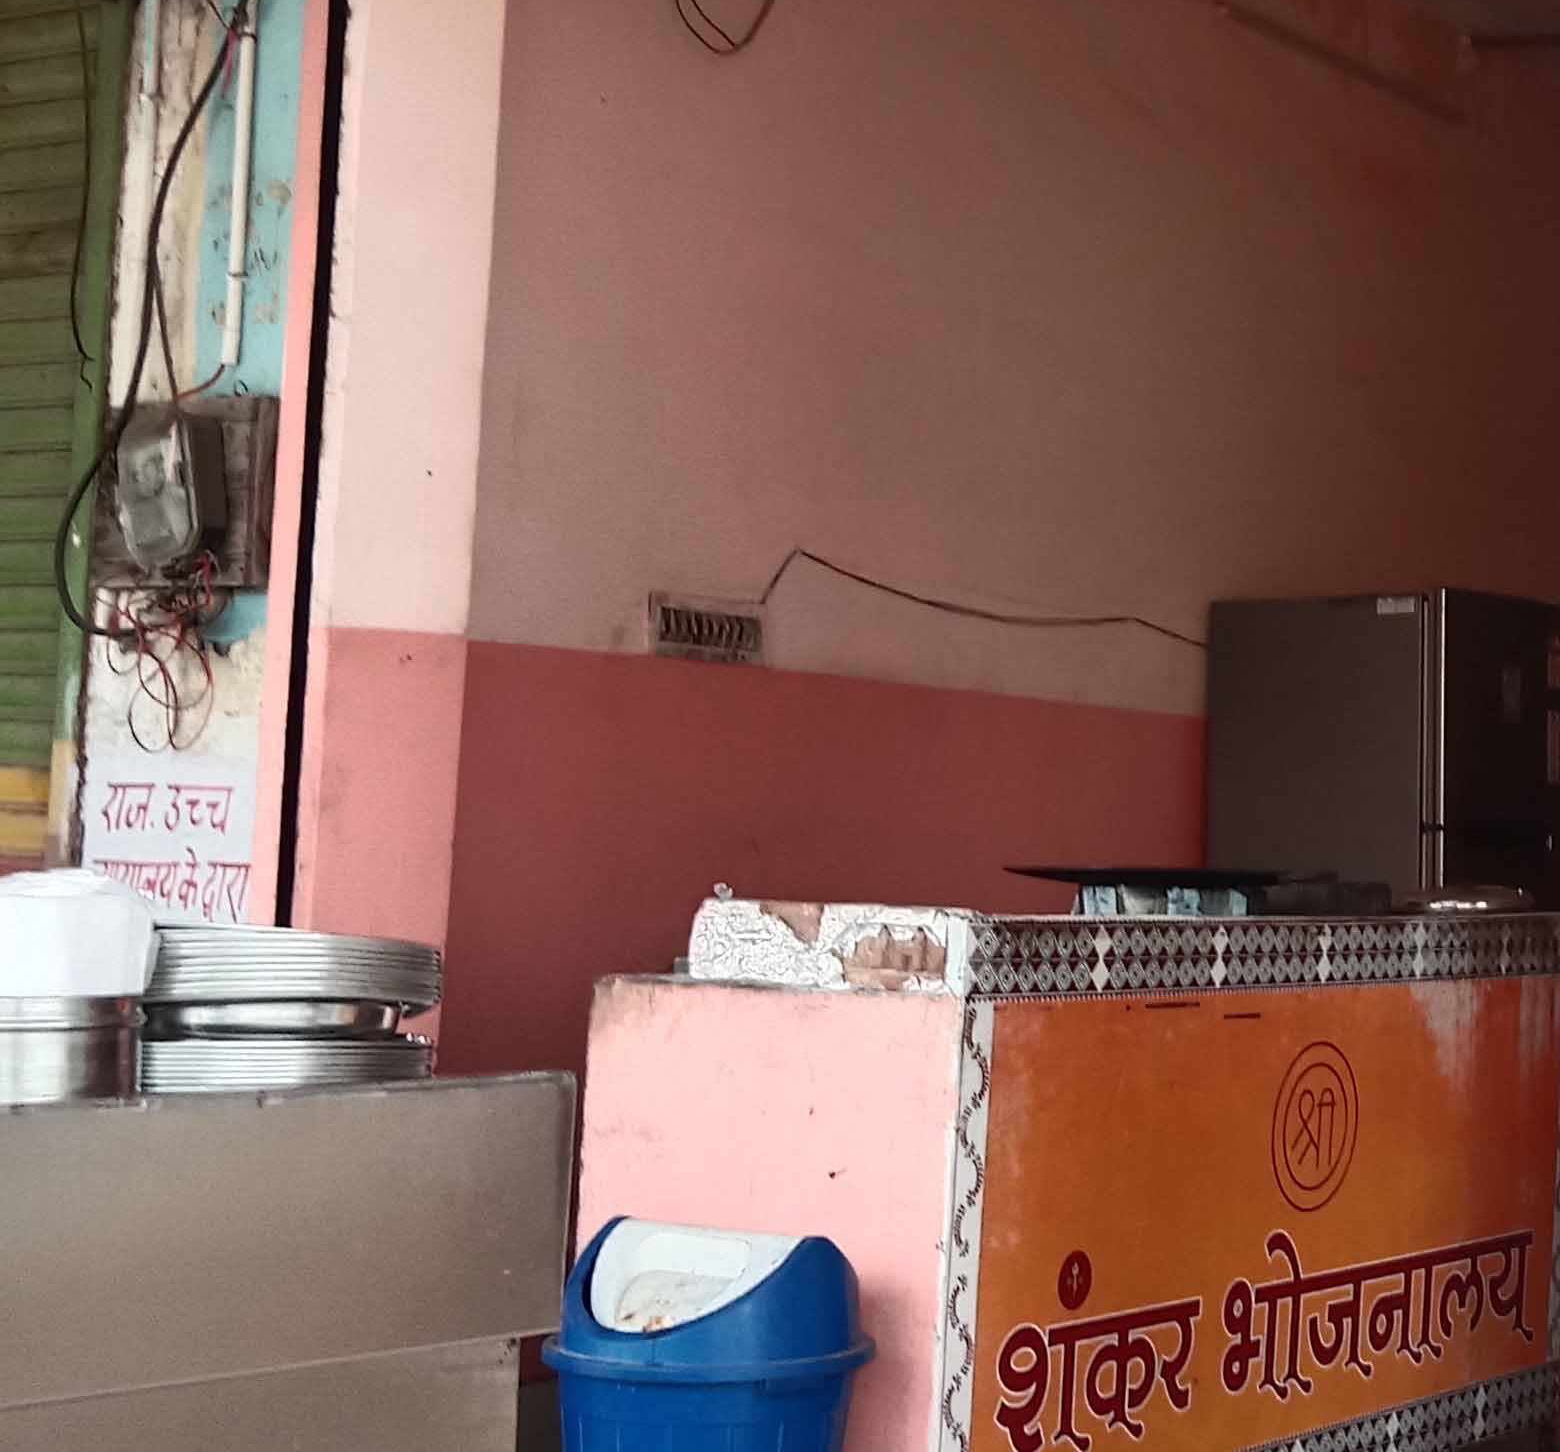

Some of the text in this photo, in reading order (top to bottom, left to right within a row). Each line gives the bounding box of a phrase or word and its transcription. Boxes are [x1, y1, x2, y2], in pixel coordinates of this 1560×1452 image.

[178, 847, 197, 910] के
[1291, 1087, 1337, 1169] श्री
[994, 1229, 1538, 1452] शंकर भोजनालय
